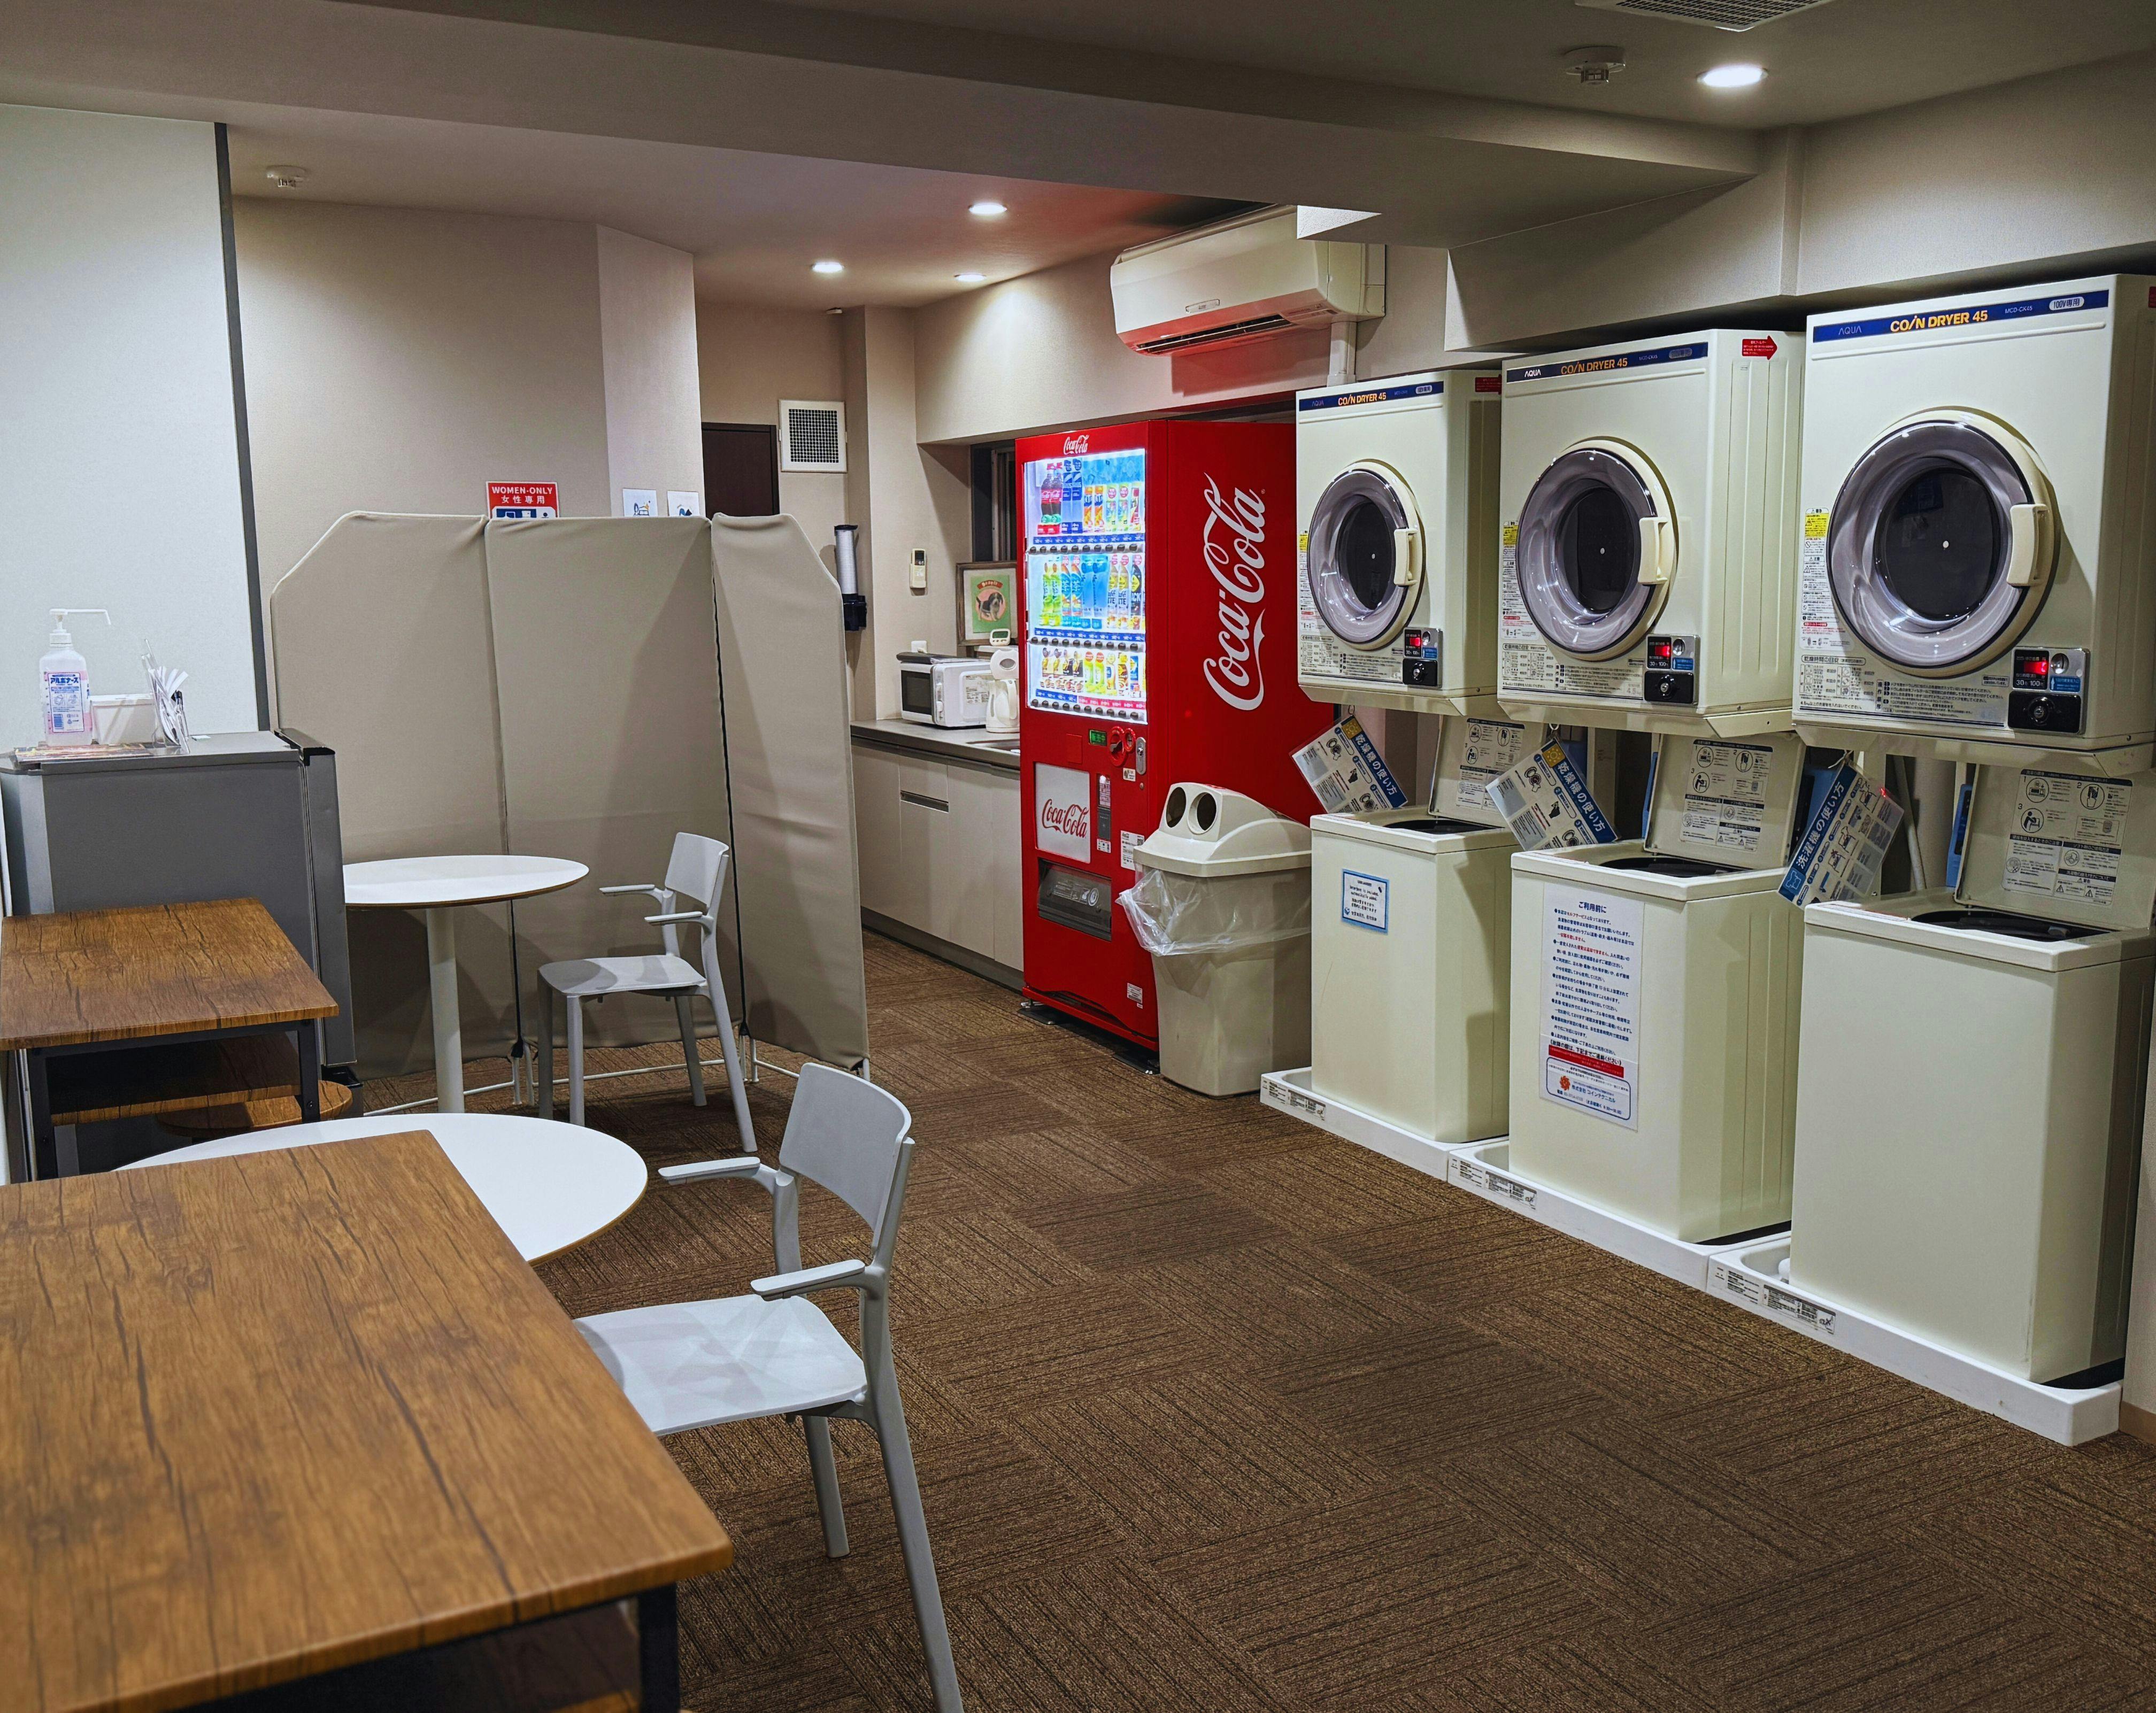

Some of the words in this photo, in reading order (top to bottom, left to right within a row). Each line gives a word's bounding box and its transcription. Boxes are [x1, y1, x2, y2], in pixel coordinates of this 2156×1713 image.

[1838, 327, 1862, 335] AQUA
[1928, 313, 1969, 328] DRYER
[1973, 310, 1988, 322] 45
[1587, 360, 1615, 372] DRYER
[1617, 358, 1627, 367] 45
[1358, 393, 1377, 404] DRYER
[1204, 473, 1265, 711] Coca-Cola
[1356, 734, 1397, 795] 乾燥機の使い方
[1558, 761, 1605, 831] 乾燥機の使い方
[1042, 799, 1089, 838] Coca-Cola
[1796, 781, 1844, 869] 洗濯機の使い方
[1578, 900, 1606, 914] ご利用前に
